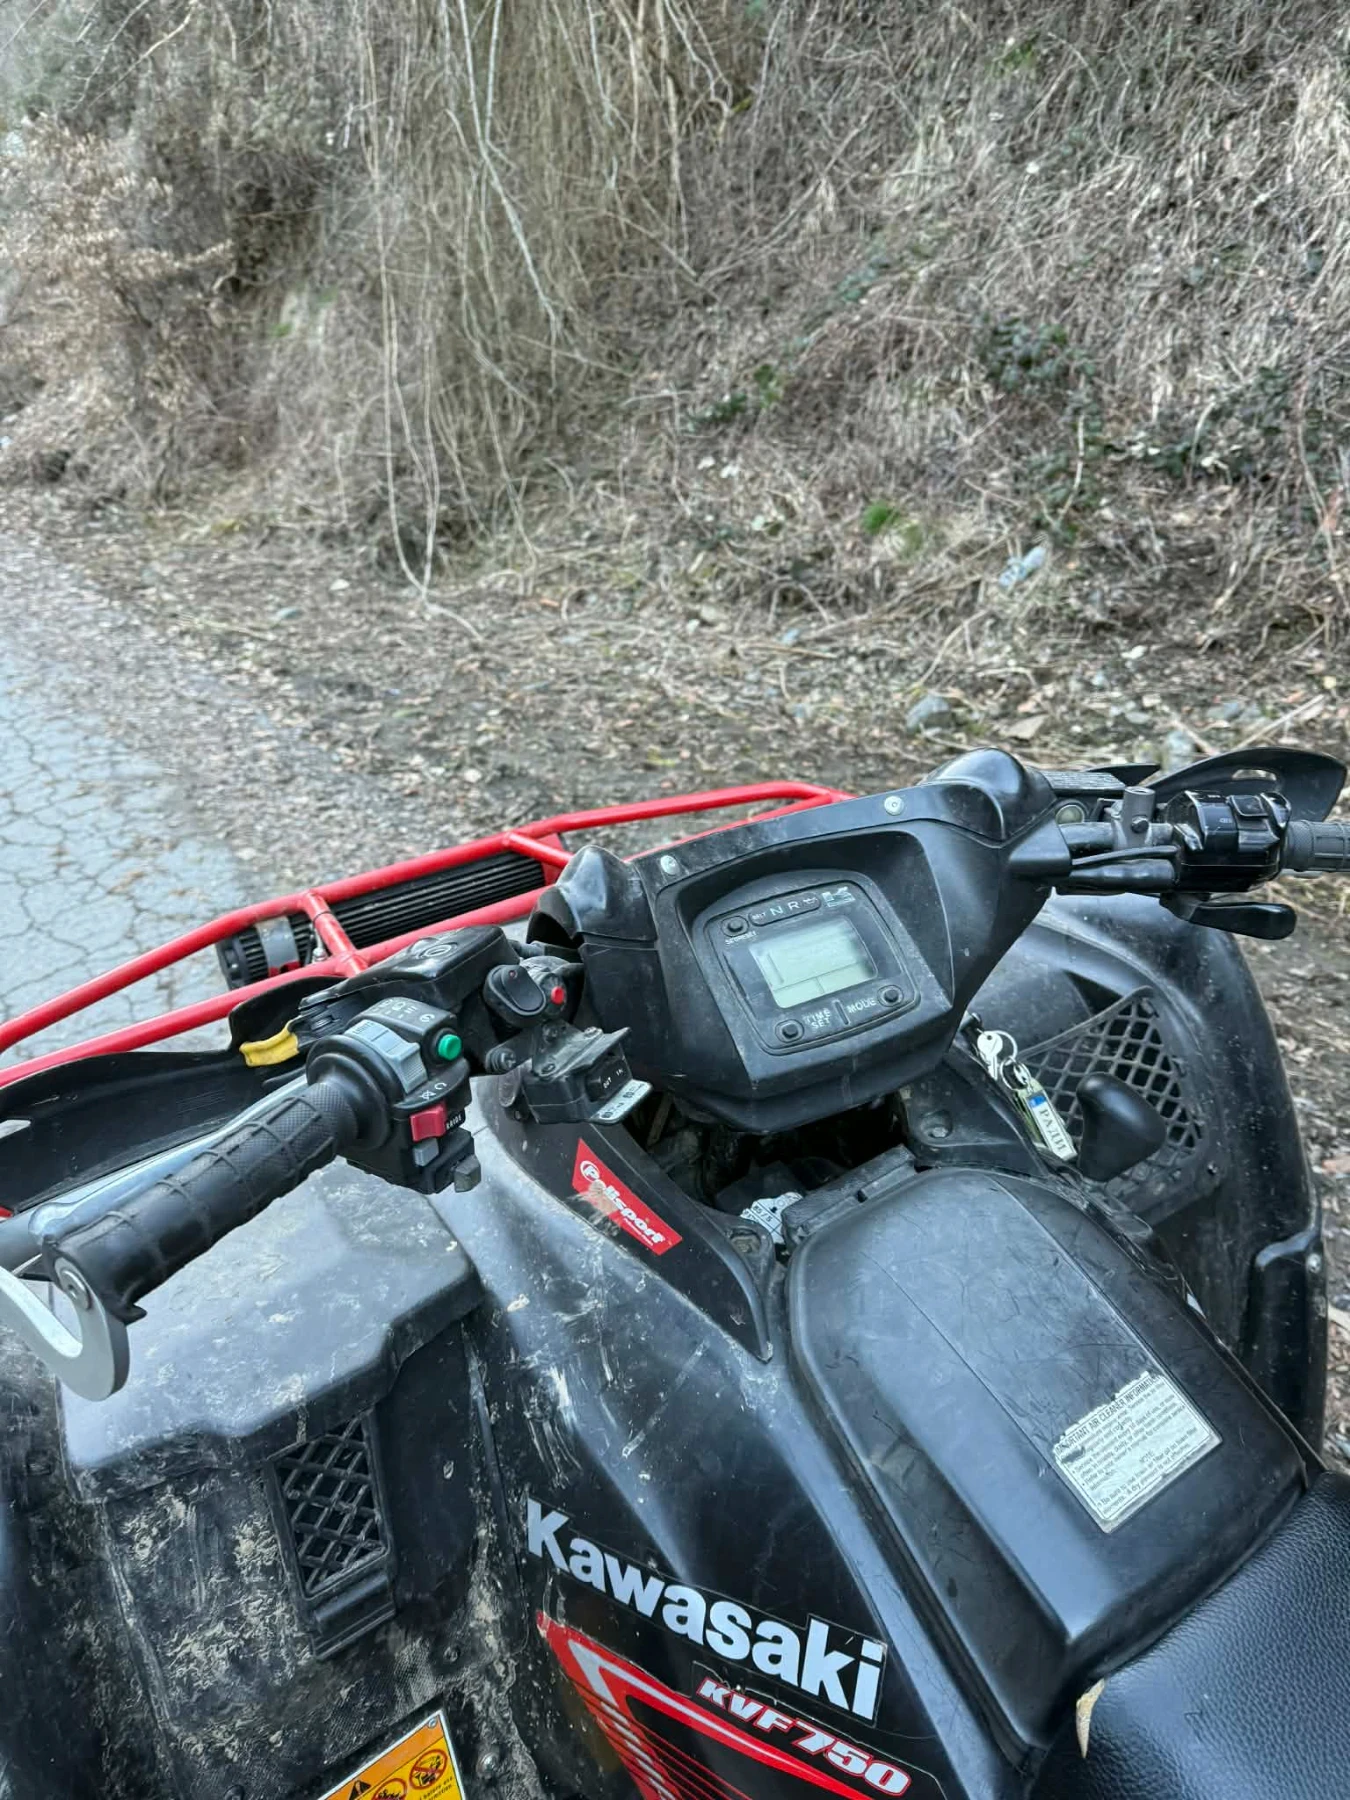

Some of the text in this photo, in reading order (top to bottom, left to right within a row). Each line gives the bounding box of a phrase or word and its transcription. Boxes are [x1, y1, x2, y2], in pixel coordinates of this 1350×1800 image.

[769, 905, 784, 917] N
[787, 900, 800, 911] R
[846, 998, 877, 1014] MODE
[803, 1009, 832, 1024] TIME
[811, 1016, 831, 1030] SET
[1088, 1417, 1100, 1429] AIR
[1098, 1398, 1125, 1421] CLEANER
[527, 1497, 886, 1721] Kawasaki
